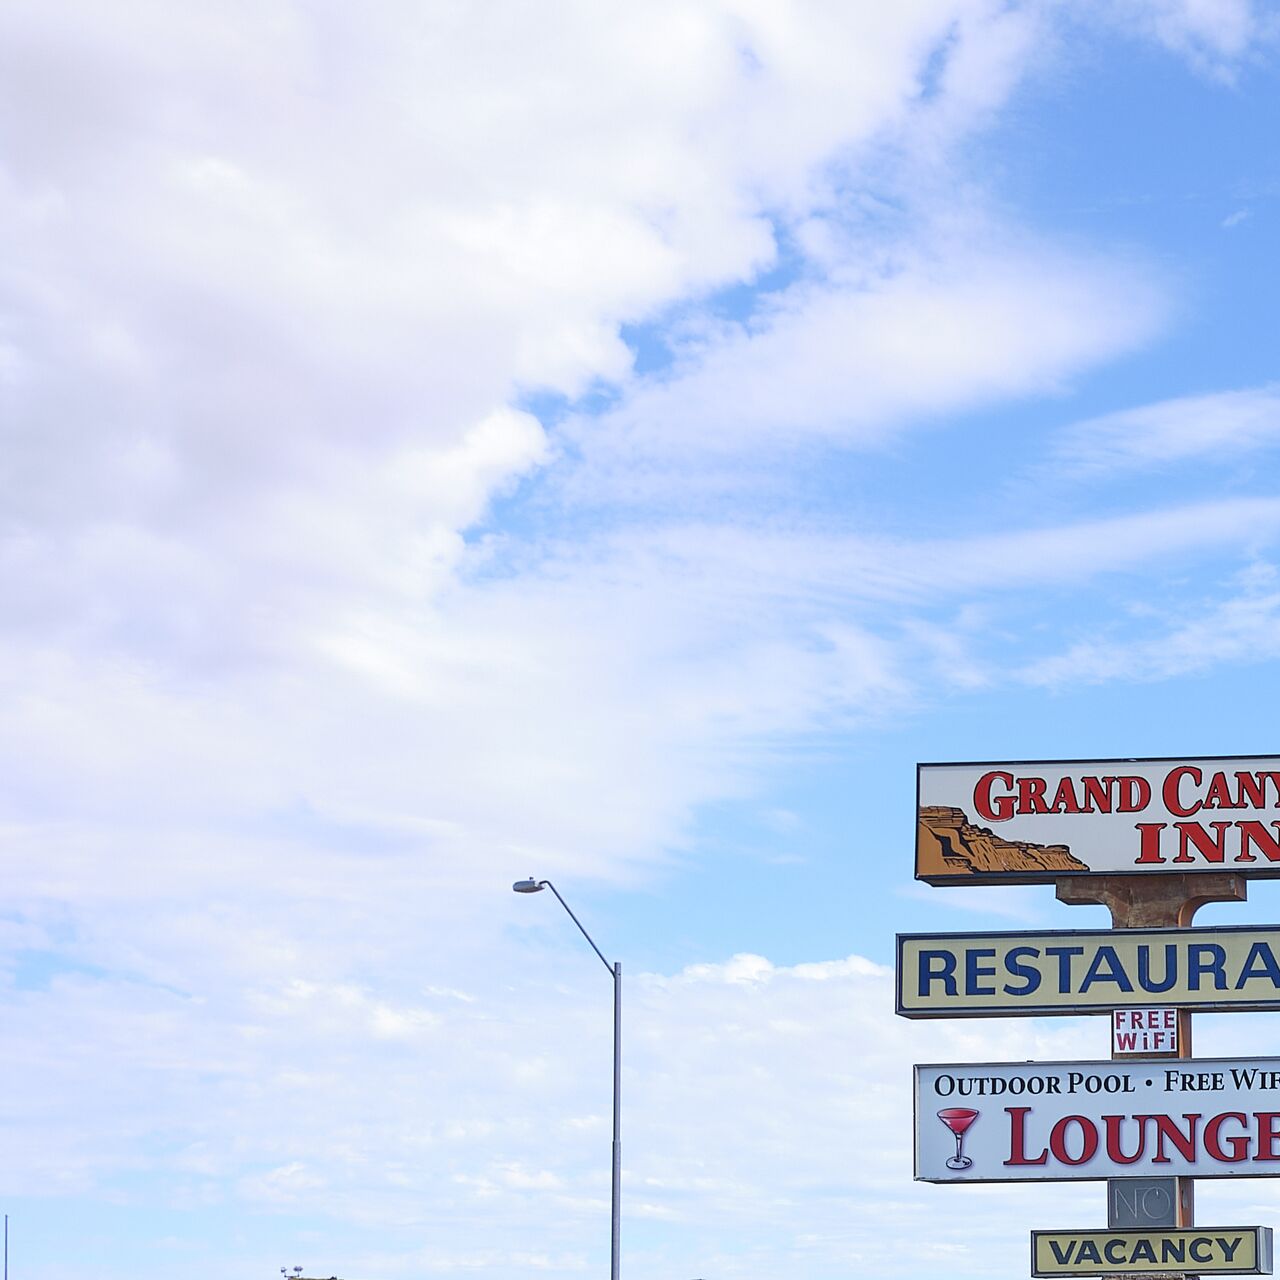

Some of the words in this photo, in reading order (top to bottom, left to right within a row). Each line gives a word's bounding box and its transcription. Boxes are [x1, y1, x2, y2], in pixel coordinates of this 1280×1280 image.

[973, 771, 1151, 822] GRAND
[1115, 1010, 1175, 1030] FREE
[1116, 1032, 1175, 1051] WiFi
[933, 1074, 1062, 1097] OUTDOOR
[1067, 1071, 1136, 1095] POOL
[1163, 1069, 1225, 1092] FREE
[1114, 1186, 1171, 1220] NO
[1048, 1236, 1243, 1266] VACANCY
